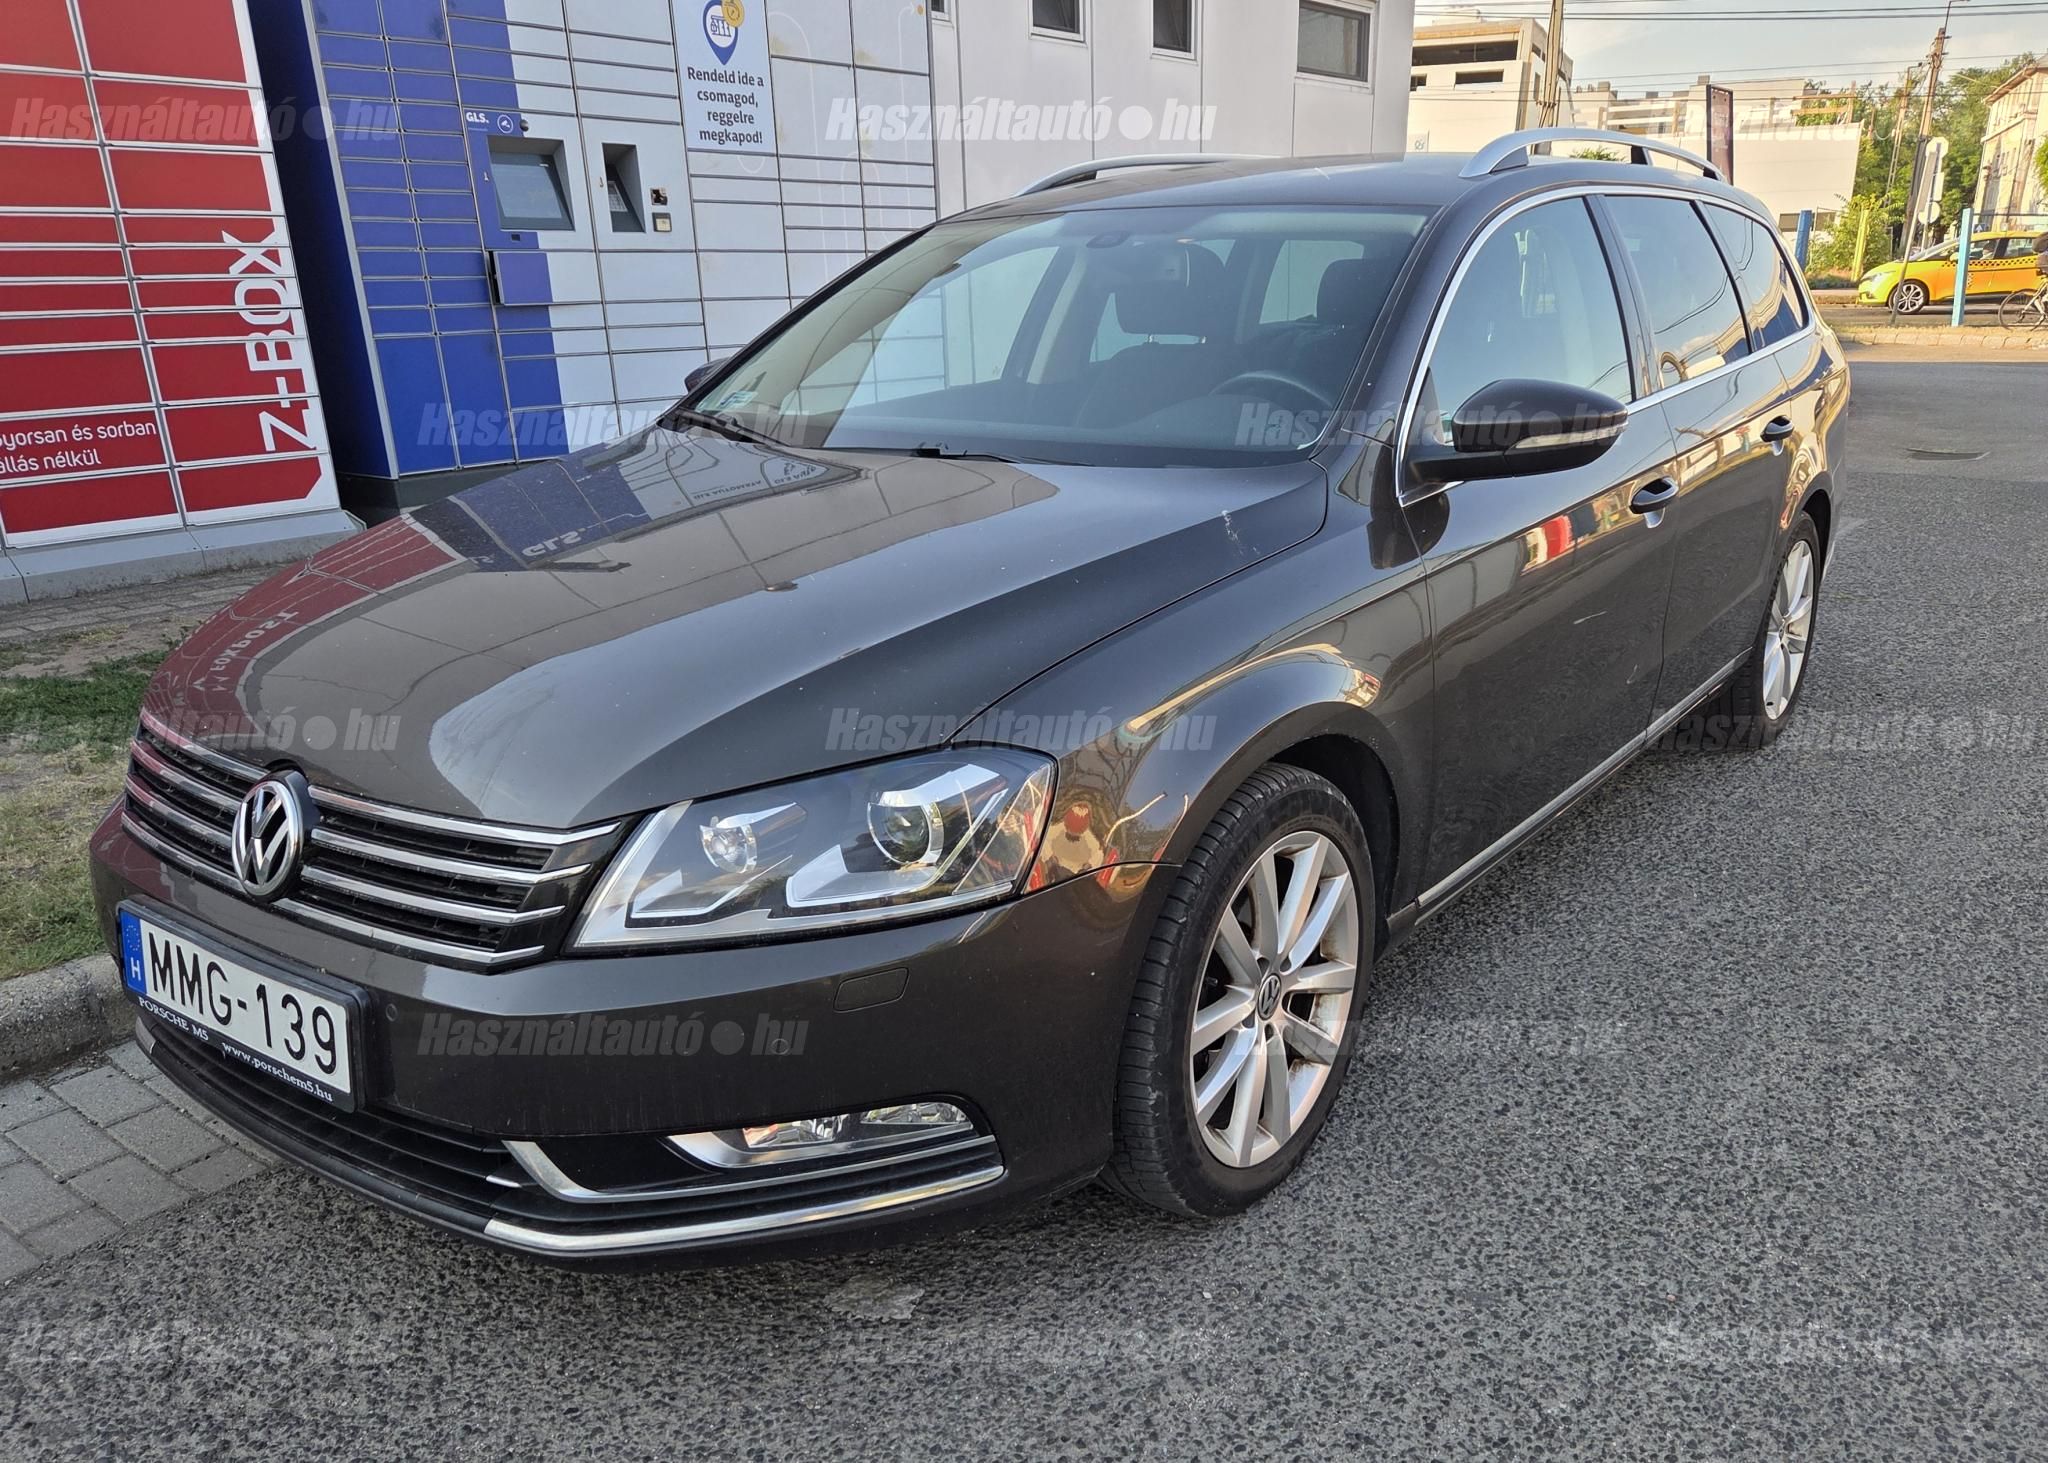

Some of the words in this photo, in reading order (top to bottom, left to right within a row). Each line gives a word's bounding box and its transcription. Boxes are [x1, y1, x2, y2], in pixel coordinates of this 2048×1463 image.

[687, 66, 736, 84] Rendeld
[738, 71, 755, 86] ide
[757, 76, 764, 87] a
[697, 90, 758, 108] csomagod,
[707, 110, 754, 126] reggelre
[699, 129, 763, 146] megkapod!
[221, 229, 317, 451] Z-BOX
[0, 429, 67, 451] yorsan
[72, 424, 93, 441] és
[97, 421, 156, 439] sorban
[43, 448, 101, 469] nélkül
[130, 956, 142, 982] H
[148, 931, 338, 1075] MMG-139
[138, 996, 190, 1032] PORSCHE
[192, 1026, 209, 1041] M5
[222, 1040, 333, 1103] www.porschem5.hu
